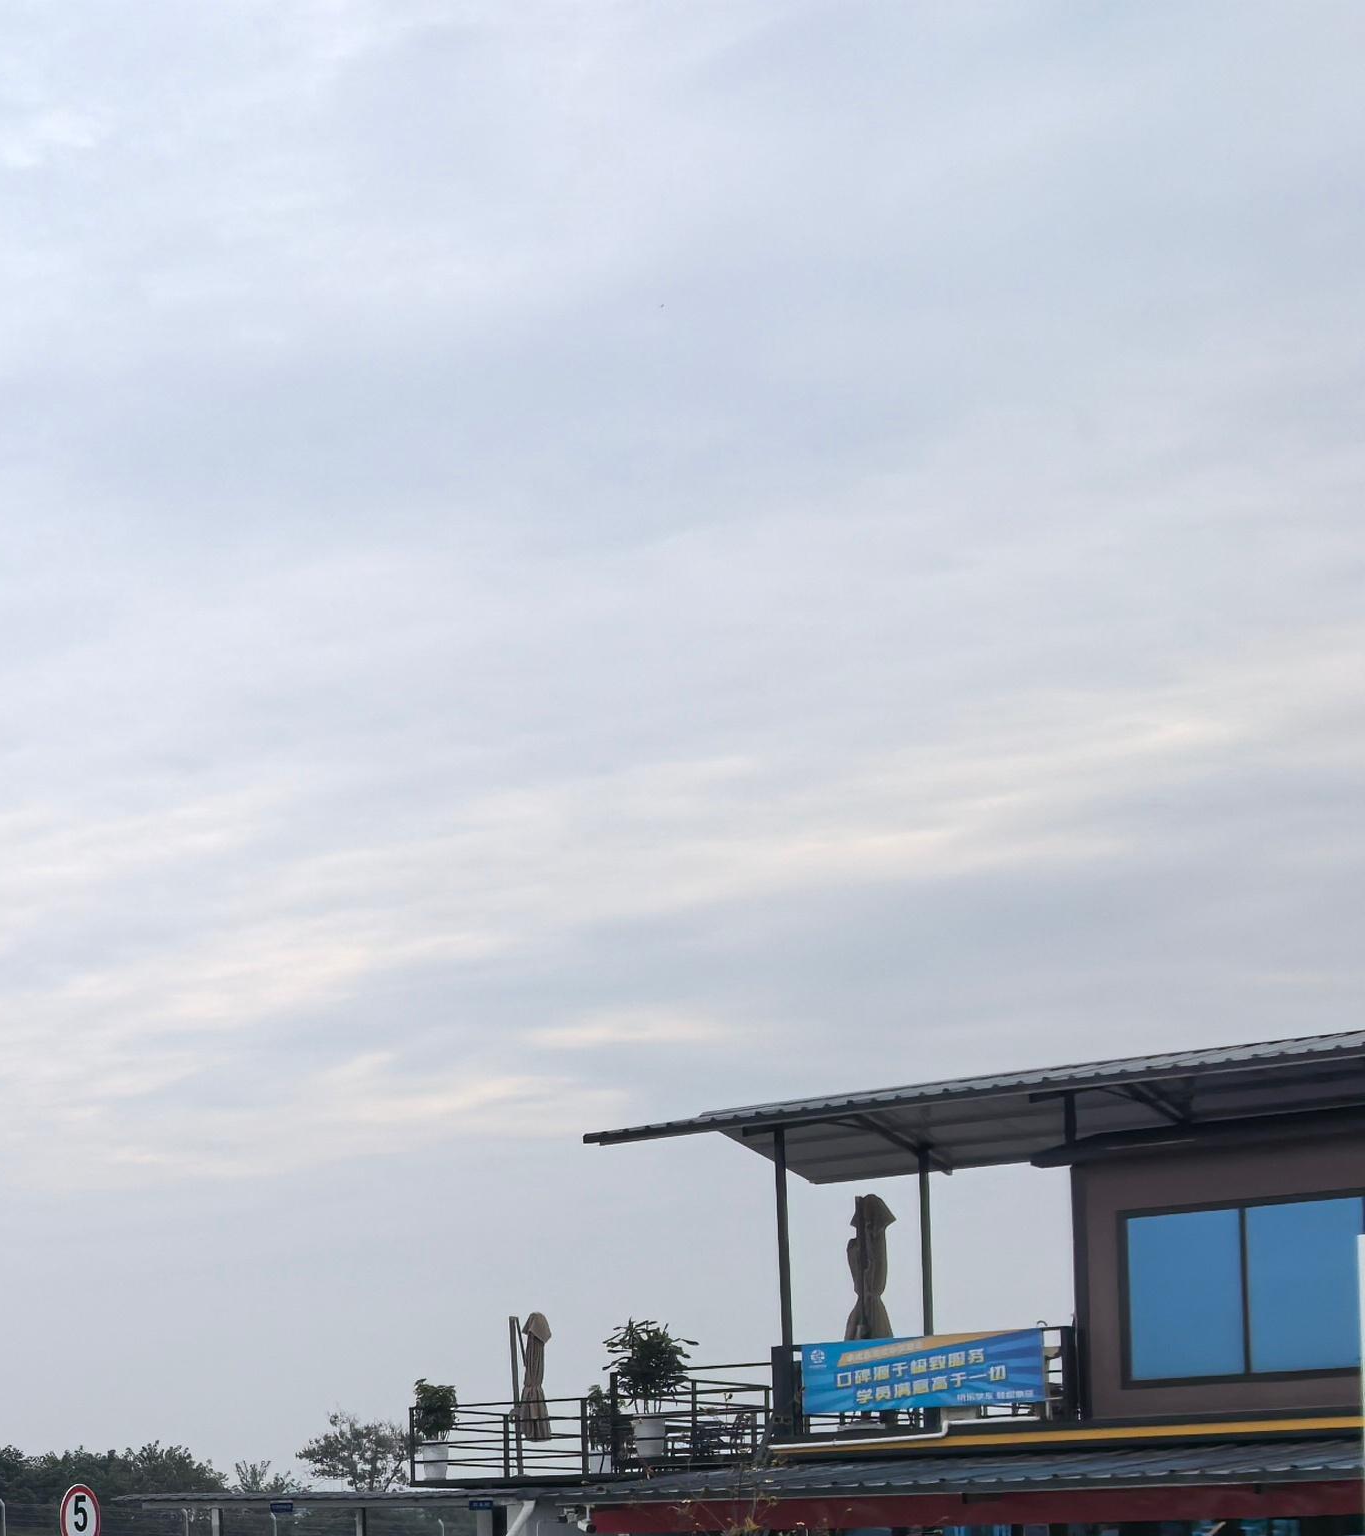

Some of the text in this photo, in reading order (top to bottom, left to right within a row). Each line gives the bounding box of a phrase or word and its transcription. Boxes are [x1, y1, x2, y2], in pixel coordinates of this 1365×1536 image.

[836, 1348, 986, 1388] 口碑源于极致服务
[856, 1365, 1007, 1404] 学员满意高于一切
[74, 1495, 88, 1532] 5
